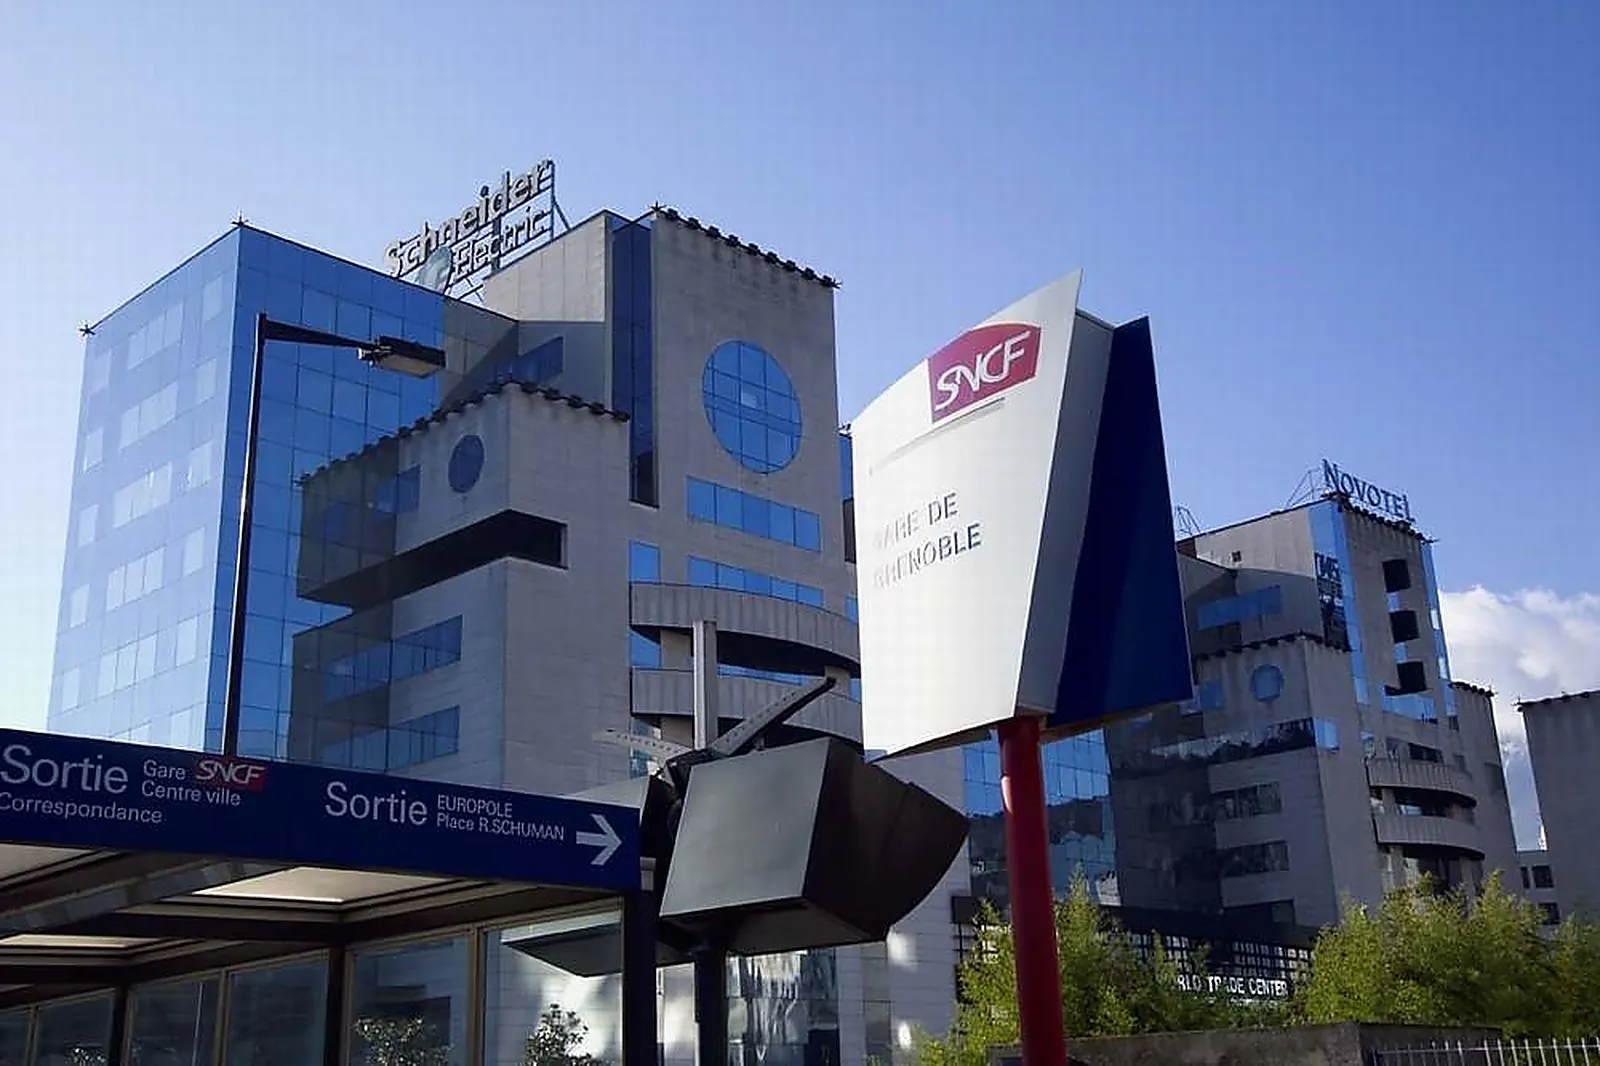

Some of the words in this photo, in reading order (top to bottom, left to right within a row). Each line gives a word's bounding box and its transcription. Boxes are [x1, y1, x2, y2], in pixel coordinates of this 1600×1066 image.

[384, 158, 554, 278] Schneider
[451, 206, 551, 276] Electric
[934, 330, 1031, 412] SNCF
[1321, 457, 1415, 523] NOVOTEL
[928, 492, 958, 526] DE
[0, 744, 128, 794] Sortie
[143, 759, 186, 780] Gare
[195, 760, 267, 784] SNCF
[0, 792, 162, 823] Correspondance
[141, 779, 201, 802] Centre
[206, 787, 241, 806] ville
[325, 781, 428, 825] Sortie
[437, 794, 513, 819] EUROPOLE
[436, 812, 475, 832] Place
[479, 816, 564, 841] R.SCHUMAN
[1208, 975, 1245, 994] TRDE
[1248, 978, 1288, 997] CENTER
